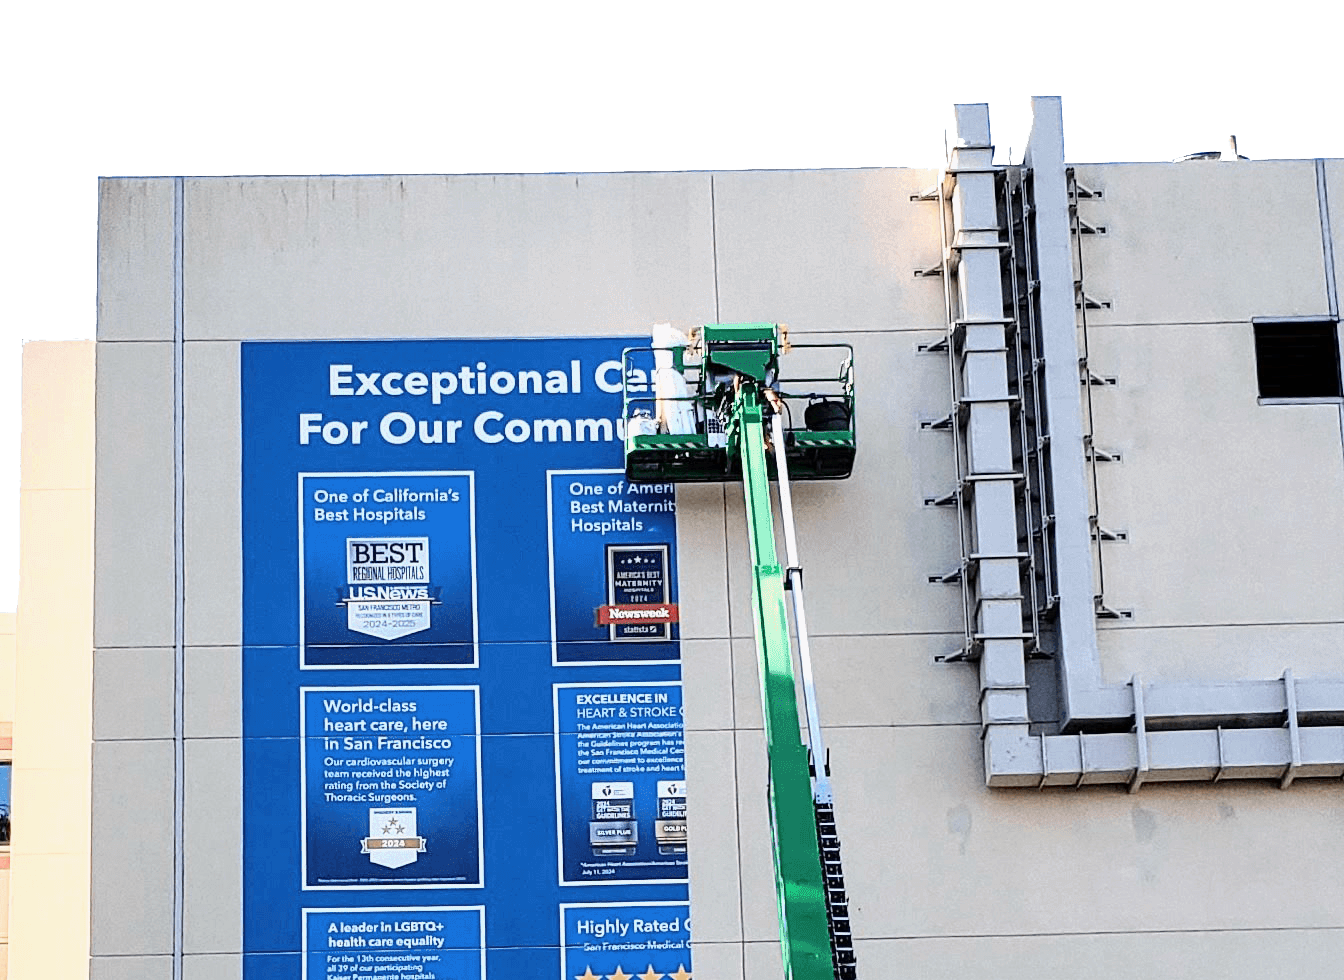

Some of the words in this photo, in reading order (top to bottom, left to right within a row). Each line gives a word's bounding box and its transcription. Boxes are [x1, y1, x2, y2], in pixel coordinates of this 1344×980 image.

[330, 360, 581, 404] Exceptional
[299, 413, 368, 445] For
[380, 411, 461, 445] Our
[570, 482, 603, 496] One
[608, 481, 624, 494] of
[314, 490, 348, 503] One
[353, 489, 369, 502] of
[373, 488, 460, 502] California's
[571, 500, 604, 514] Best
[314, 508, 349, 521] Best
[354, 507, 426, 525] Hospitals
[572, 518, 643, 535] Hospitals
[352, 543, 423, 564] BEST
[353, 567, 386, 580] REGIONAL
[387, 566, 424, 580] HOSPITALS
[609, 608, 670, 619] Newsweek
[324, 698, 417, 713] World-class
[577, 694, 653, 705] EXCELLENCE
[655, 693, 668, 703] IN
[577, 708, 616, 719] HEART
[619, 708, 627, 718] &
[630, 707, 677, 718] STROKE
[324, 717, 367, 732] heart
[370, 721, 408, 732] care,
[412, 717, 447, 731] here
[325, 737, 339, 750] in
[344, 737, 372, 750] San
[378, 736, 451, 749] Francisco
[324, 757, 344, 767] Our
[346, 756, 415, 766] cardiovascular
[418, 758, 454, 767] surgery
[324, 770, 349, 778] team
[352, 768, 393, 778] received
[396, 768, 411, 777] the
[414, 768, 449, 779] highest
[325, 781, 353, 792] rating
[356, 781, 378, 790] from
[381, 781, 396, 790] the
[399, 780, 434, 791] Society
[436, 779, 447, 788] of
[325, 793, 366, 802] Thoracic
[368, 792, 417, 803] Surgeons.
[382, 840, 405, 848] 2024
[328, 923, 338, 933] A
[341, 922, 378, 933] leader
[381, 922, 392, 933] in
[395, 922, 444, 932] LGBTQ+
[578, 918, 630, 937] Highly
[634, 917, 679, 933] Rated
[329, 937, 366, 948] health
[368, 938, 393, 946] care
[396, 936, 445, 948] equality
[584, 943, 601, 951] San
[602, 942, 646, 951] Francisco
[648, 941, 684, 949] Medical
[342, 955, 354, 963] the
[422, 954, 441, 962] year,
[374, 964, 423, 973] participating
[401, 973, 435, 980] hospitals
